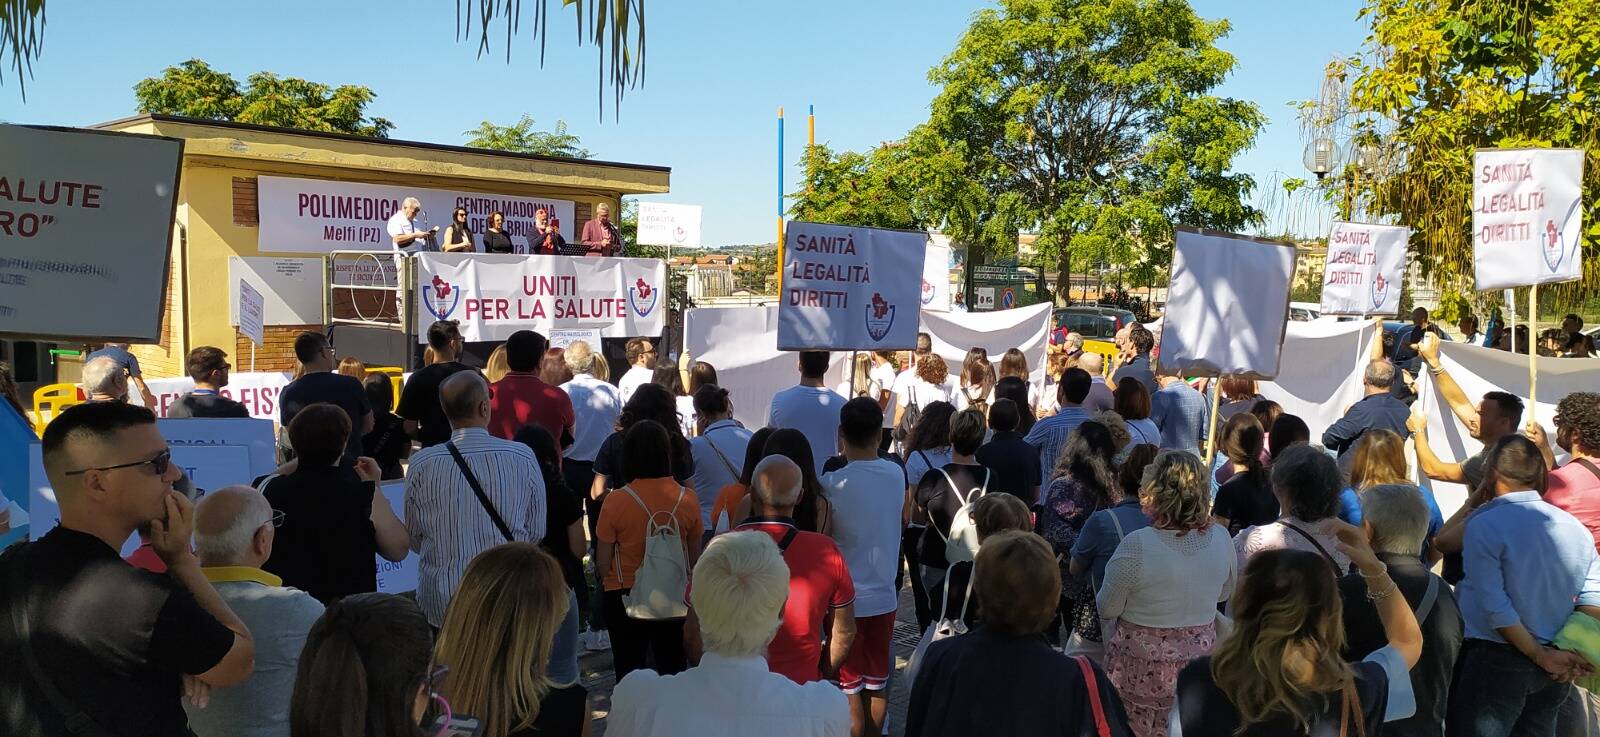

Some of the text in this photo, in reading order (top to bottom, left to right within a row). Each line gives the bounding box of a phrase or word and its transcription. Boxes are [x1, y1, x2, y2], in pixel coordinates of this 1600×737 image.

[1482, 159, 1533, 183] SANITÀ
[1482, 187, 1545, 213] LEGALITÀ
[323, 225, 381, 243] Melfi (PZ)
[1335, 230, 1370, 245] SANITÀ
[1481, 222, 1530, 244] DIRITTI
[795, 233, 857, 255] SANITÀ
[1332, 250, 1377, 265] LEGALITÀ
[792, 261, 870, 283] LEGALITÀ
[1331, 271, 1363, 285] DIRITTI
[523, 275, 576, 296] UNITI
[790, 288, 848, 308] DIRITTI
[465, 298, 627, 320] PER LA SALUTE
